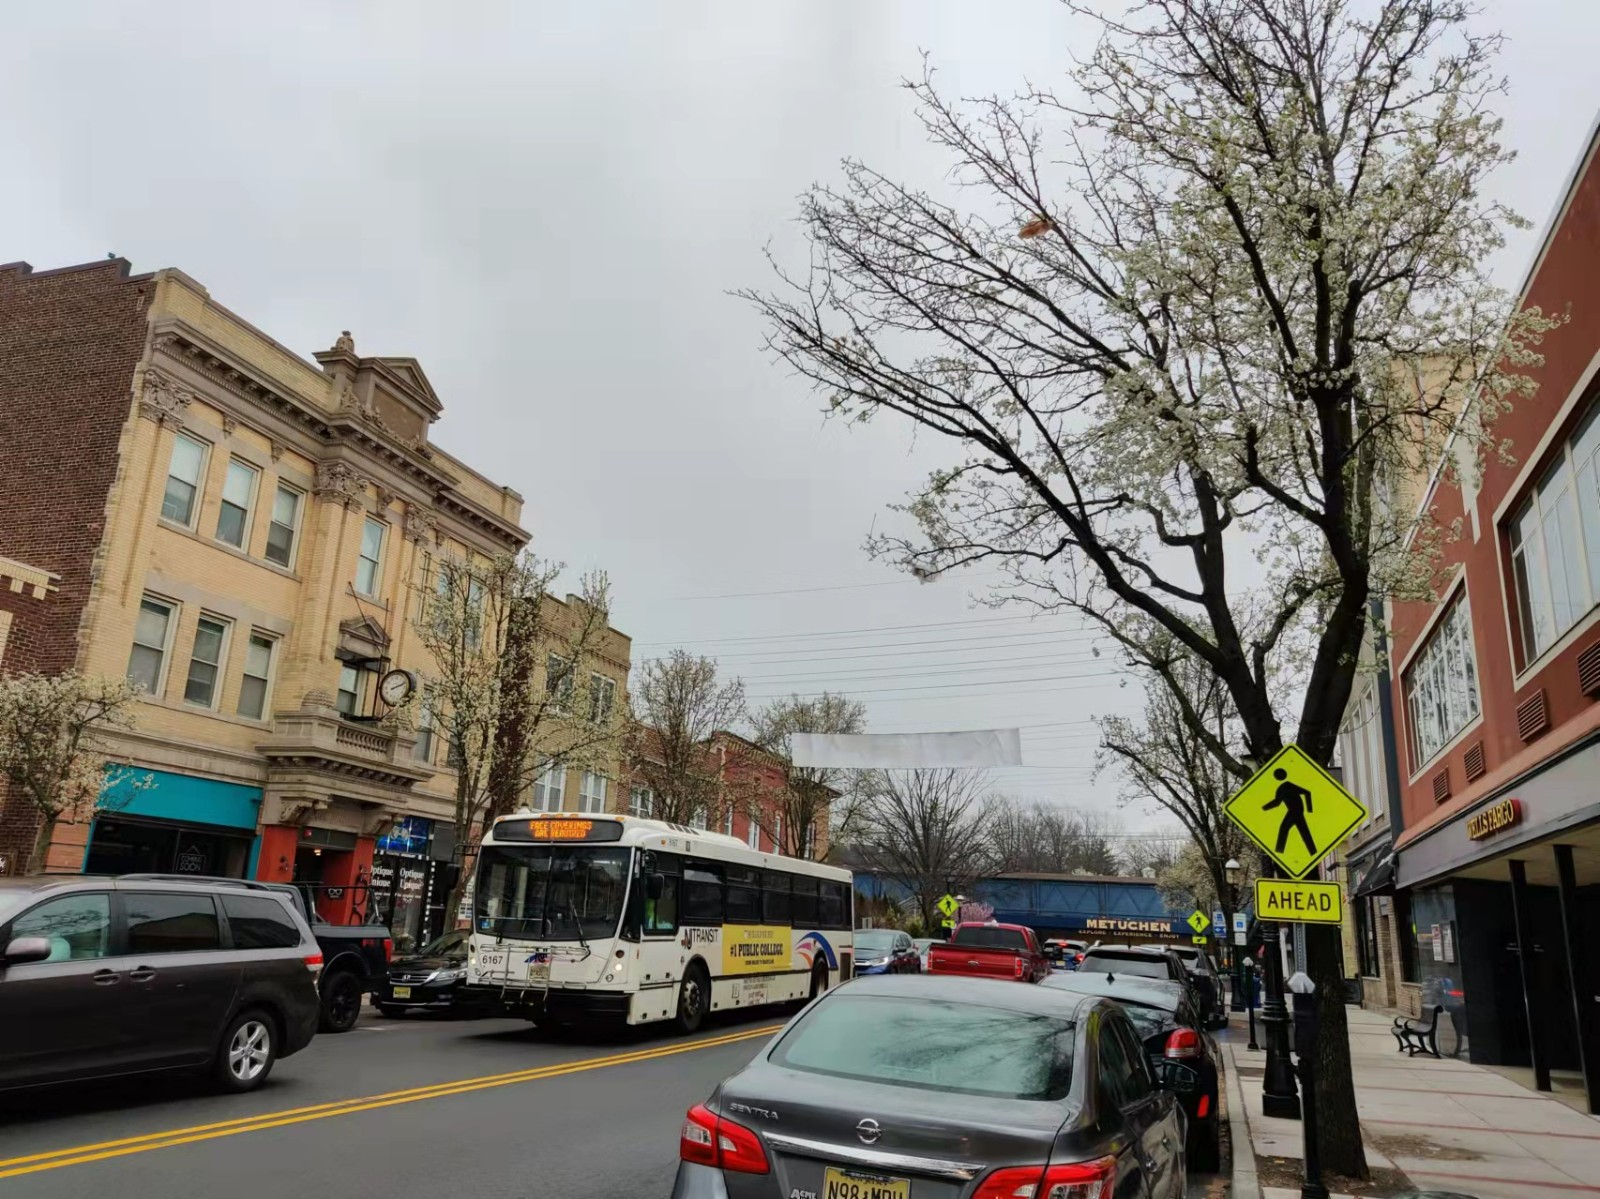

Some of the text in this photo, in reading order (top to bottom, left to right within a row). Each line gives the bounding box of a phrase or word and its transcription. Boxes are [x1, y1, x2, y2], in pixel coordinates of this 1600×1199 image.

[1488, 800, 1514, 831] FARGO
[530, 821, 593, 830] FACE COVERINGS
[534, 830, 586, 838] ARE REQUIRED
[180, 862, 201, 871] SOON
[400, 868, 424, 879] Optique
[371, 877, 391, 887] nique
[1267, 890, 1331, 911] AHEAD
[1086, 918, 1171, 932] METUCHEN
[692, 928, 718, 943] TRANSIT
[738, 943, 759, 957] PUBLIC
[760, 943, 784, 956] COLLEGE
[482, 955, 504, 965] 6167
[730, 1102, 779, 1120] SENTRA
